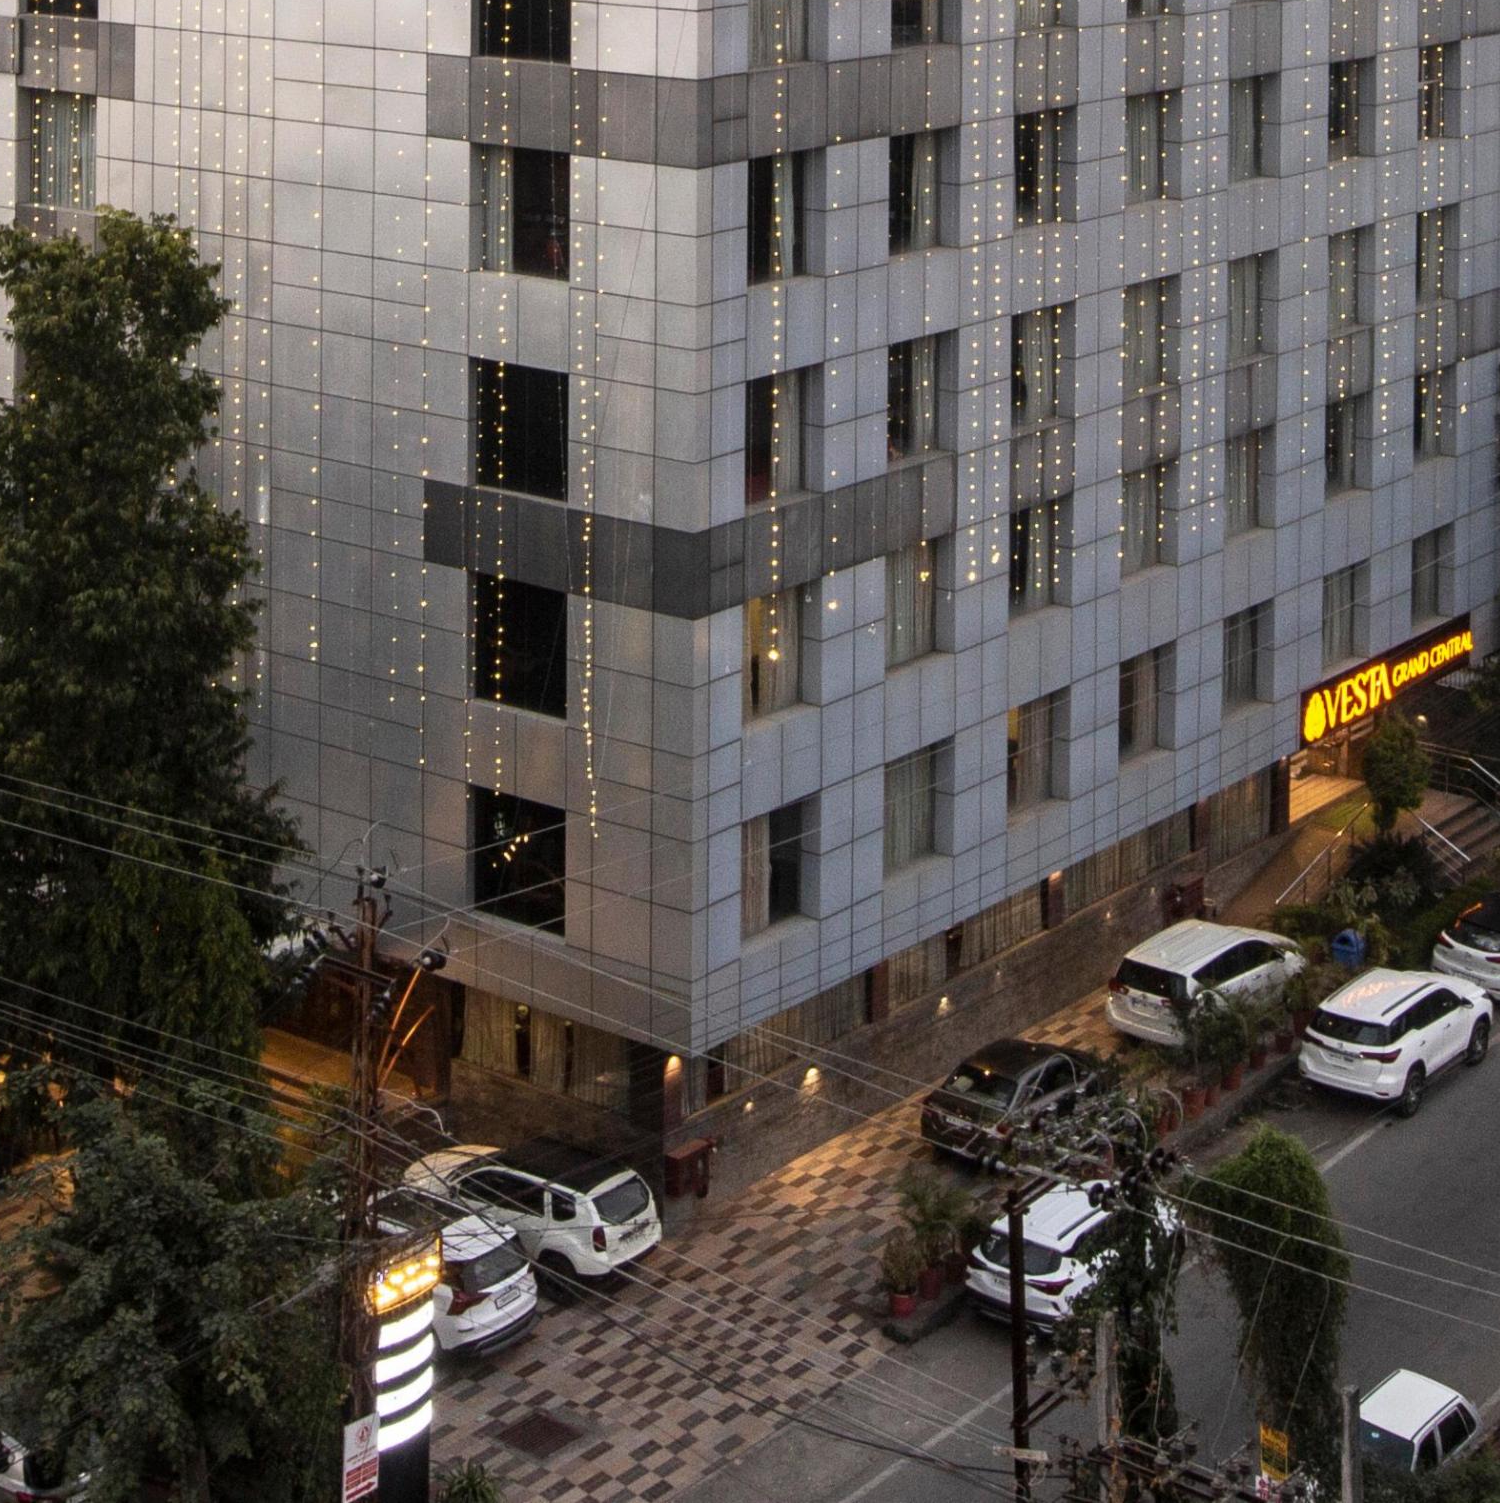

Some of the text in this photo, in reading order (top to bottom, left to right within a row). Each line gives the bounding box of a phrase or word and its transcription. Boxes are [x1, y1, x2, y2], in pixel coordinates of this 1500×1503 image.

[1324, 631, 1474, 728] VESTA GRAND CENTRAL
